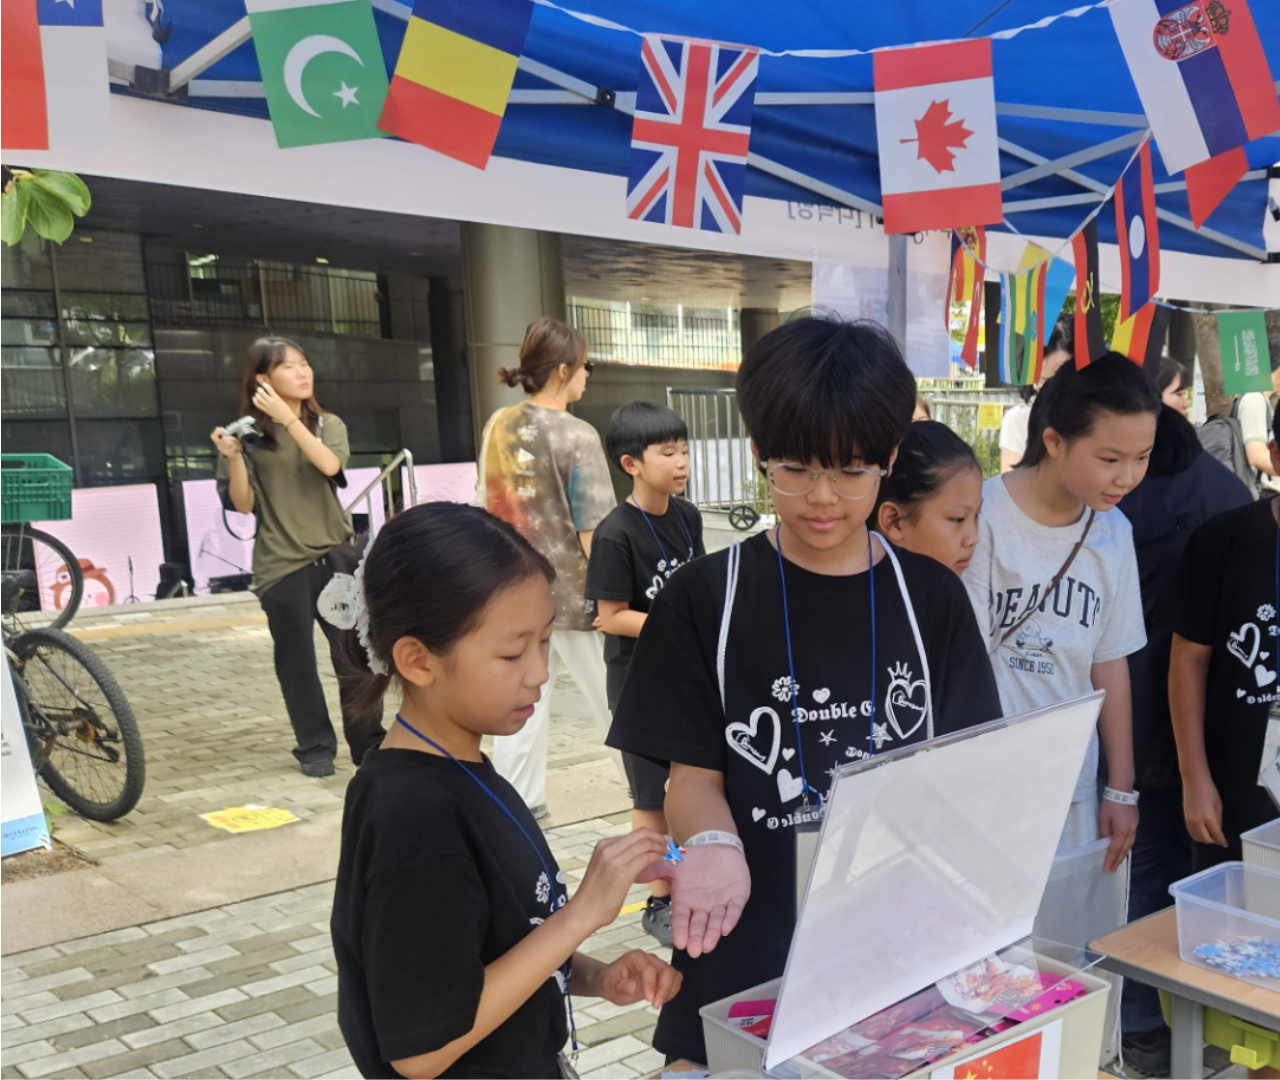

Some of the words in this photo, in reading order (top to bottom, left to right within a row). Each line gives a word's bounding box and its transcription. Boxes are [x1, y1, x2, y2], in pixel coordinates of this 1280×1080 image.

[1009, 656, 1035, 674] SINCE
[1037, 660, 1055, 675] 1950
[791, 702, 858, 724] Double
